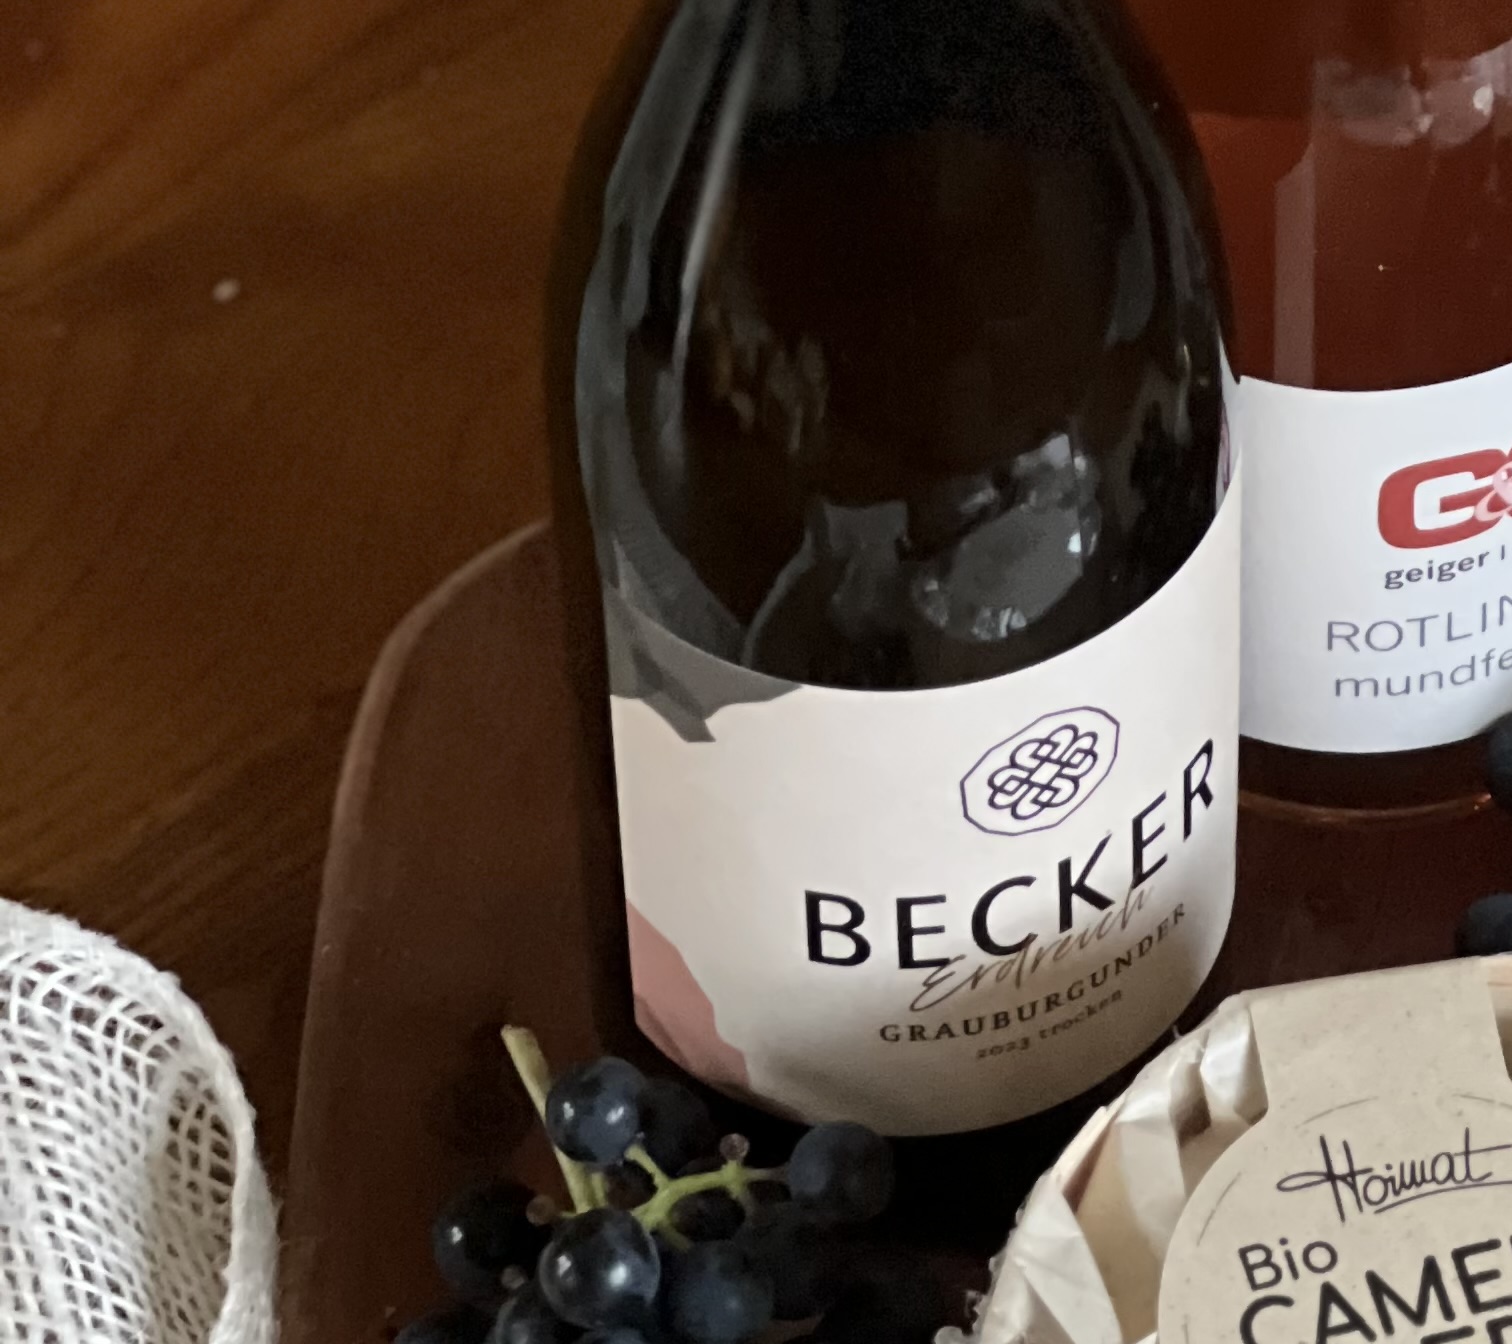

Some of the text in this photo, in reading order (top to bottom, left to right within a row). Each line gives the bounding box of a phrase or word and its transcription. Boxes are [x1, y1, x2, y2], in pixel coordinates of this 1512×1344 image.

[1384, 551, 1489, 590] geiger
[804, 738, 1214, 968] BECKER
[879, 902, 1186, 1043] GRAUBURGUNDER
[1238, 1237, 1338, 1291] Bio
